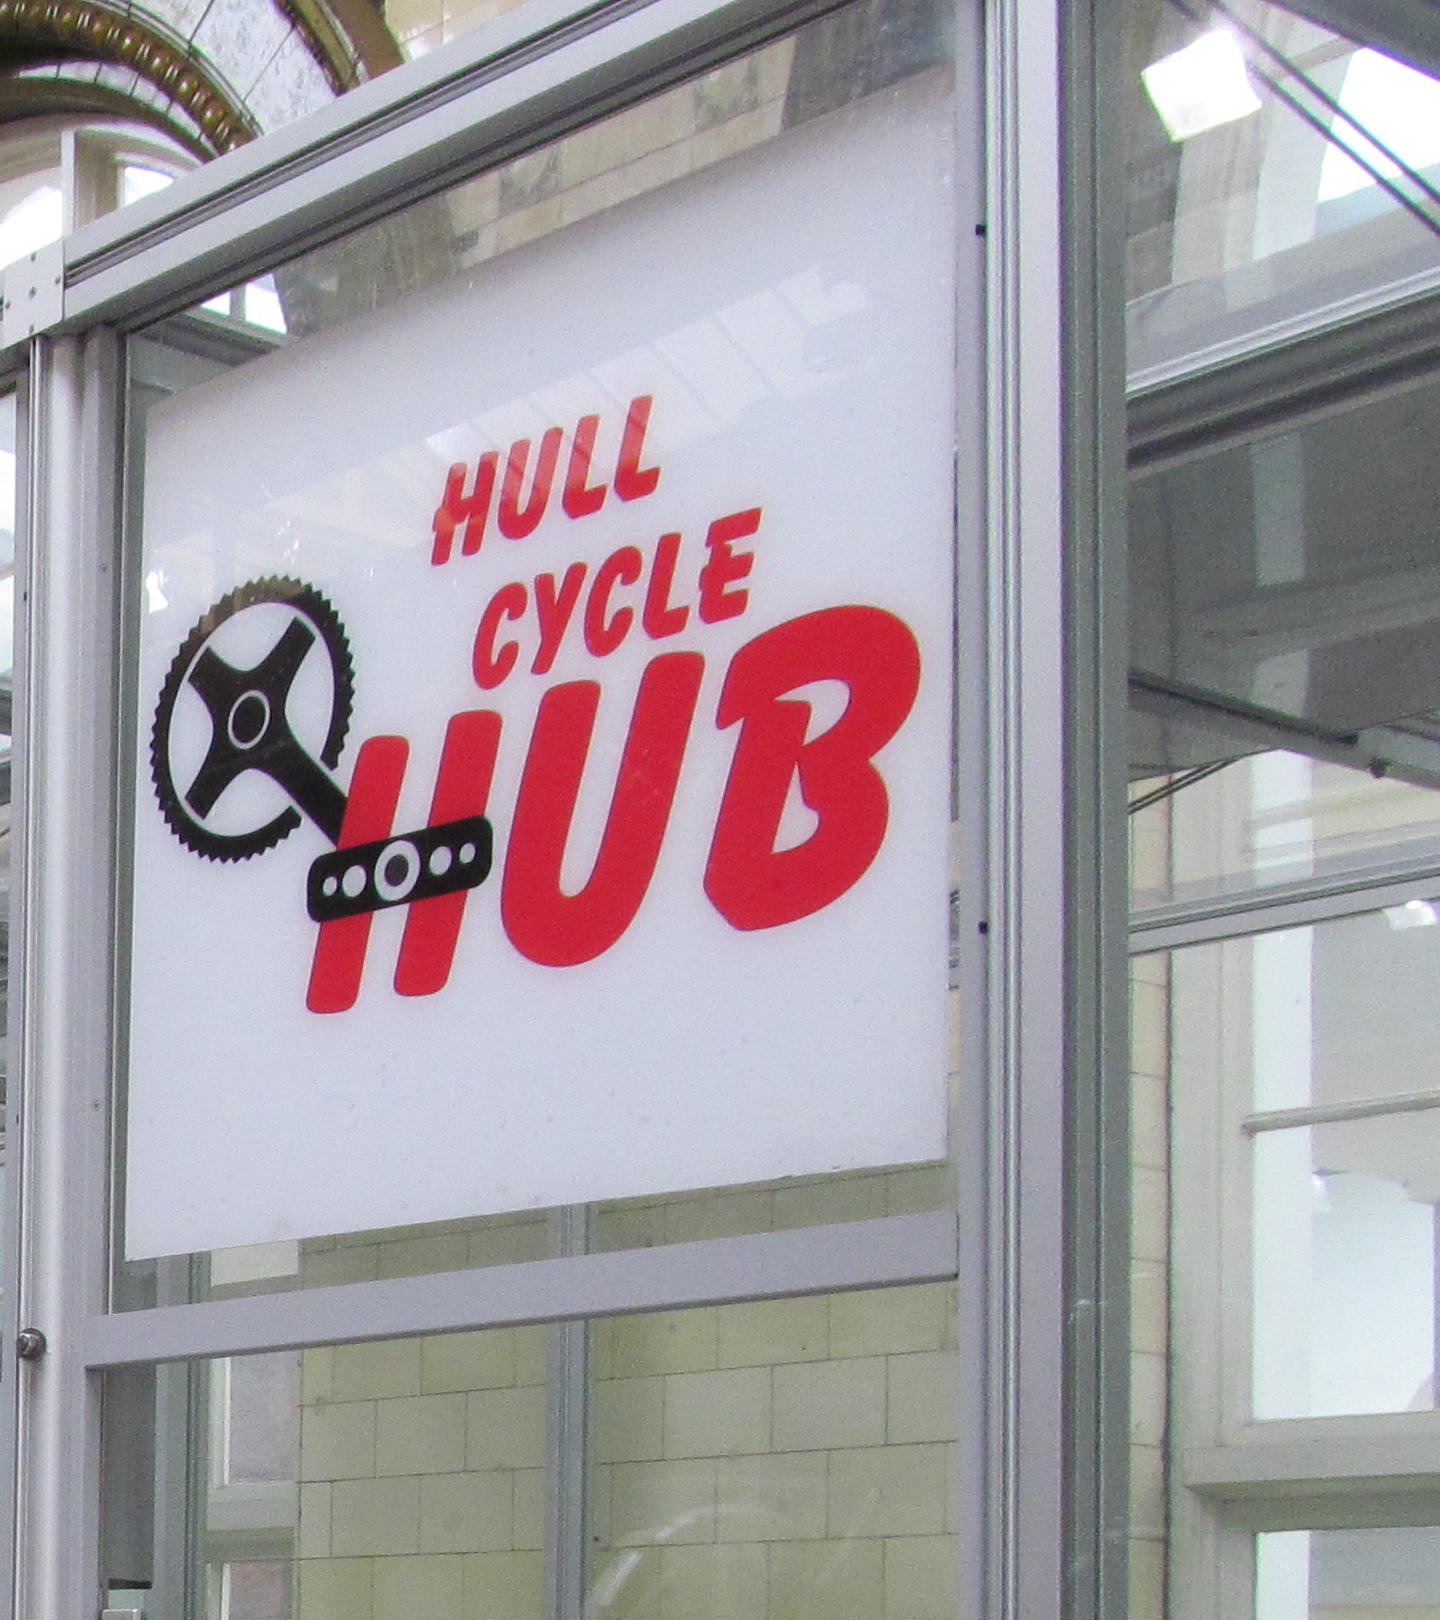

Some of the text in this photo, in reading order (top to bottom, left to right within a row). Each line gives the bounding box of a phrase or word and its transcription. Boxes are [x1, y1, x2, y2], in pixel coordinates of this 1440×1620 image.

[430, 394, 662, 566] HULL
[472, 506, 763, 690] CYCLE
[305, 604, 921, 1015] HUB
